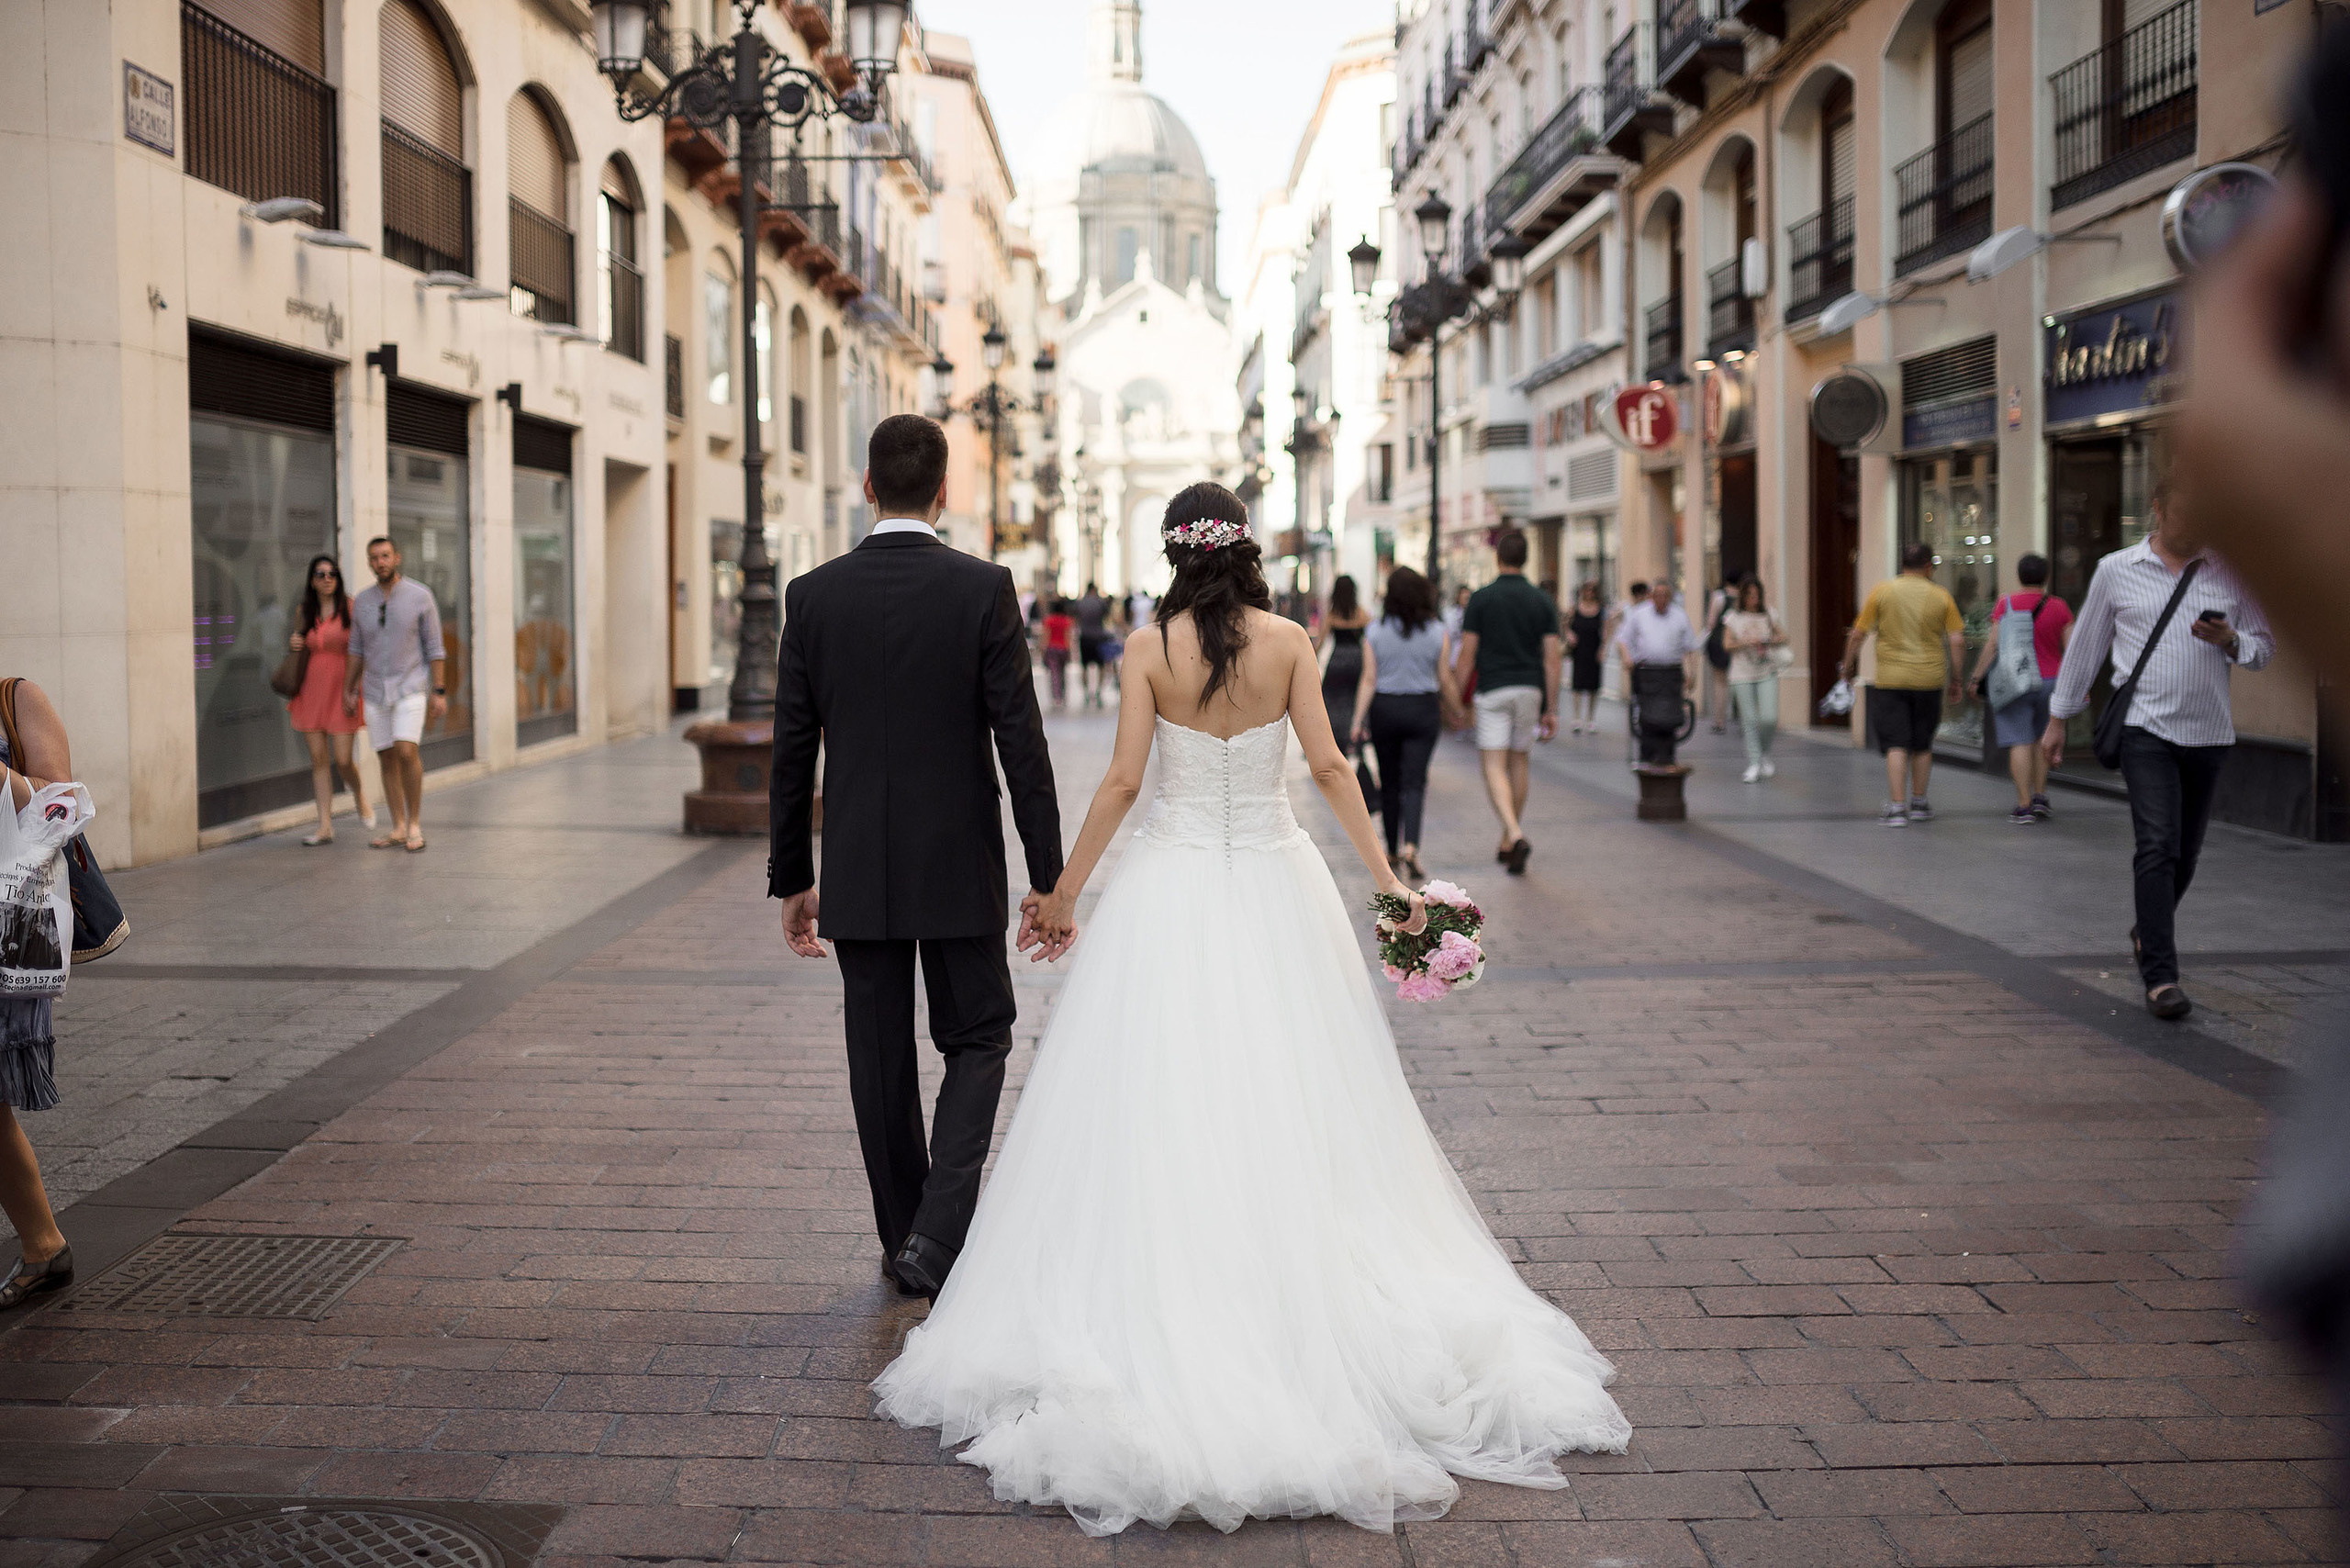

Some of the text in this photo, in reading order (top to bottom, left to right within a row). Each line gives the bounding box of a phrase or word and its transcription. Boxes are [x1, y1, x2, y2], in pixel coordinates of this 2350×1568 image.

[1625, 391, 1665, 445] if
[15, 976, 31, 985] 639
[33, 976, 50, 984] 157
[51, 974, 67, 984] 600
